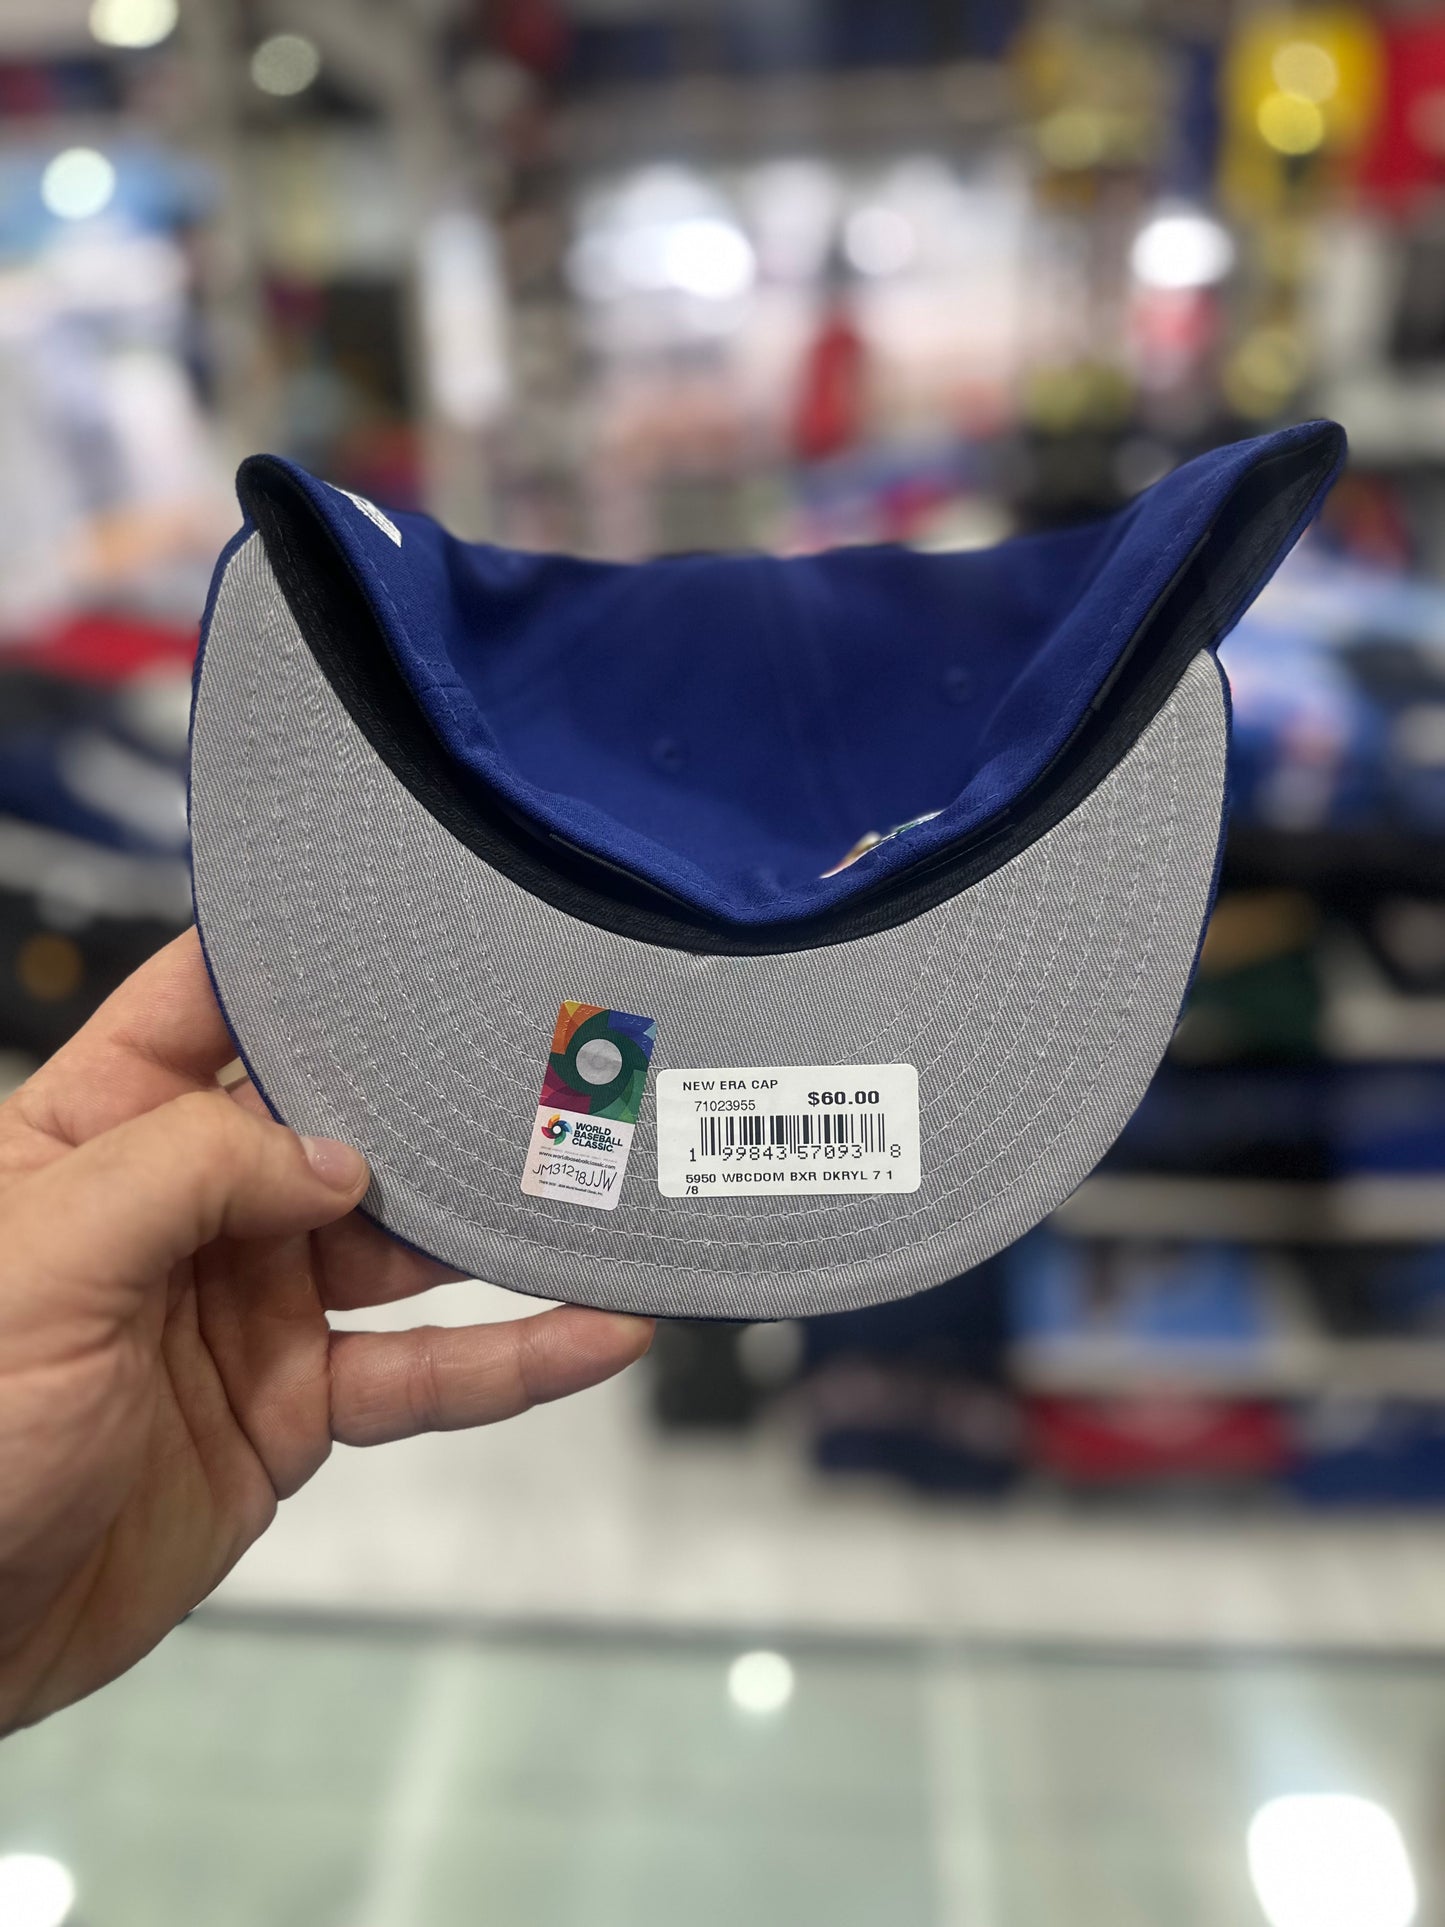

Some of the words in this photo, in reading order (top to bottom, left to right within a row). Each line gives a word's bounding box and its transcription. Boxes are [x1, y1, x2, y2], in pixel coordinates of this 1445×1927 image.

[683, 1081, 715, 1091] NEW
[720, 1080, 746, 1090] ERA
[751, 1079, 778, 1089] CAP
[807, 1090, 880, 1107] $60.00
[694, 1100, 755, 1112] 71023955
[576, 1122, 611, 1136] WORLD
[572, 1138, 614, 1152] CLASSIC
[573, 1130, 623, 1147] BASEBALL
[690, 1148, 696, 1162] 1
[722, 1146, 787, 1161] 99843
[797, 1144, 862, 1160] 57093
[890, 1144, 901, 1158] 8
[532, 1163, 617, 1192] JM31218JJW
[685, 1174, 716, 1184] 5950
[722, 1172, 785, 1183] WBCDOM
[790, 1171, 817, 1182] BXR
[823, 1171, 868, 1181] DKRYL
[873, 1171, 880, 1181] 7
[886, 1170, 893, 1181] 1
[685, 1186, 698, 1196] /8
